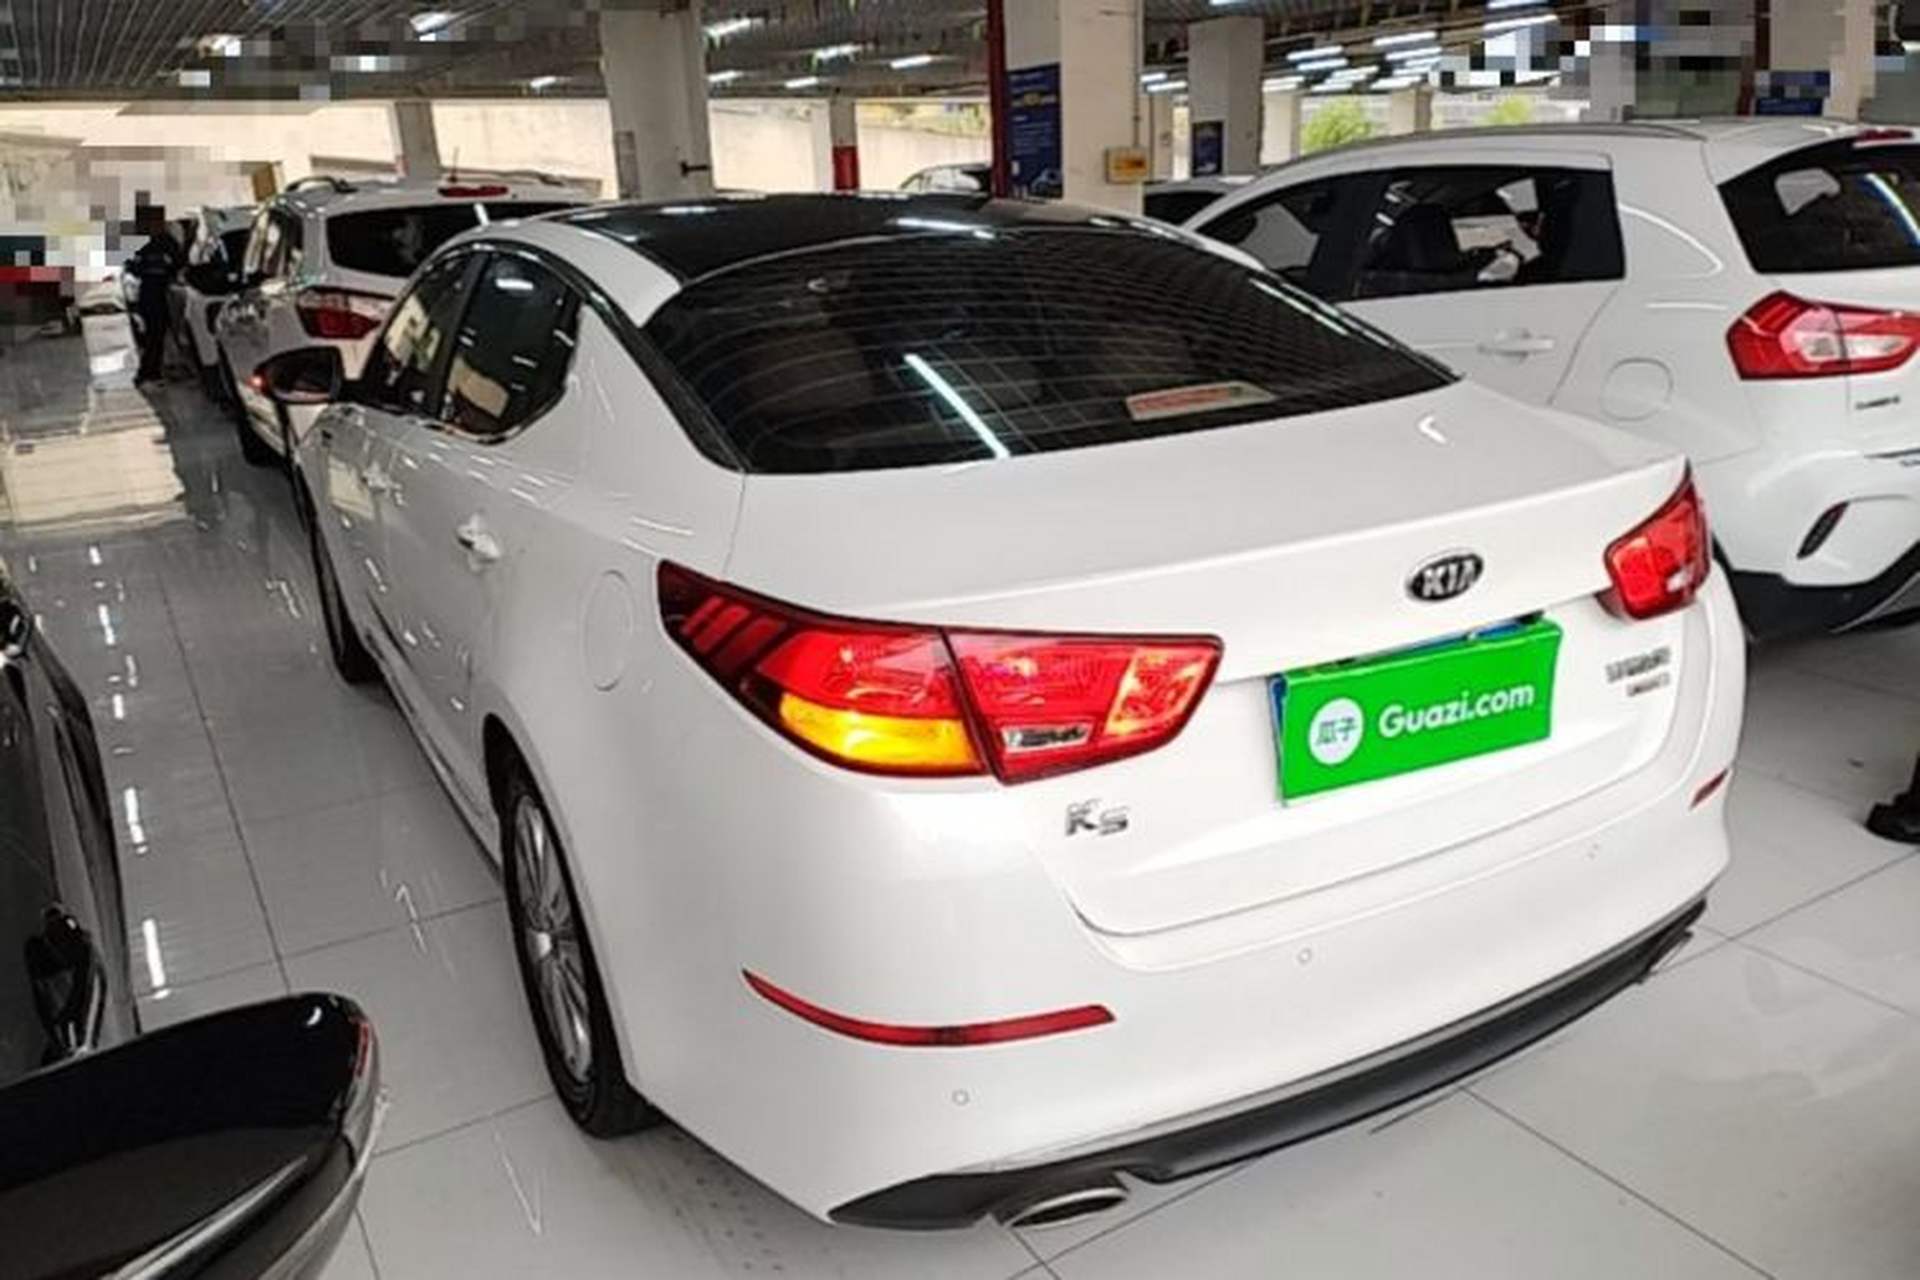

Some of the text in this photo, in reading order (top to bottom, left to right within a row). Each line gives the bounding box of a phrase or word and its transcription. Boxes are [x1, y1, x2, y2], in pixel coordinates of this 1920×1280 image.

[1421, 558, 1477, 597] KIA
[1316, 716, 1358, 745] 瓜子
[1378, 684, 1535, 738] Guazi.com
